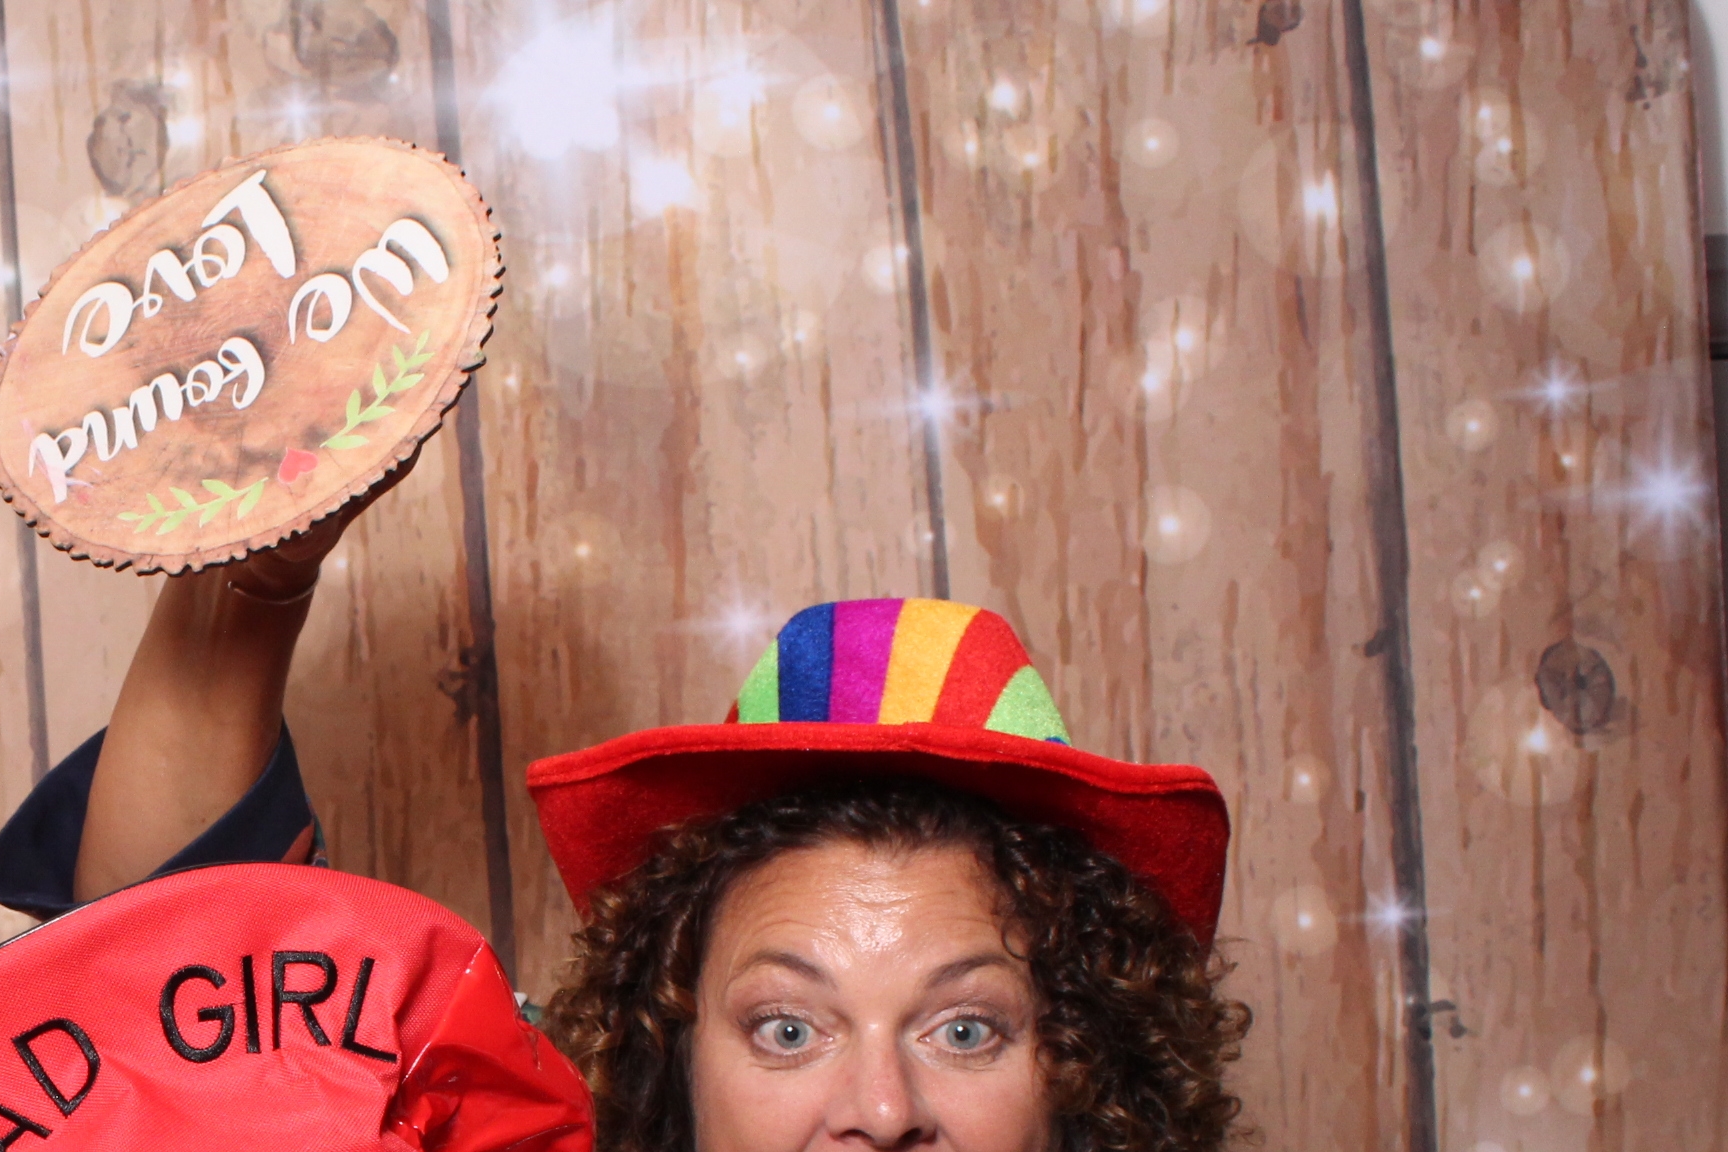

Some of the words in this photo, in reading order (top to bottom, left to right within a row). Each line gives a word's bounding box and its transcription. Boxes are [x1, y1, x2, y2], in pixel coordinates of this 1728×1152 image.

[62, 169, 297, 358] Love
[289, 217, 450, 345] We
[28, 336, 266, 504] found
[158, 950, 398, 1064] GIRL
